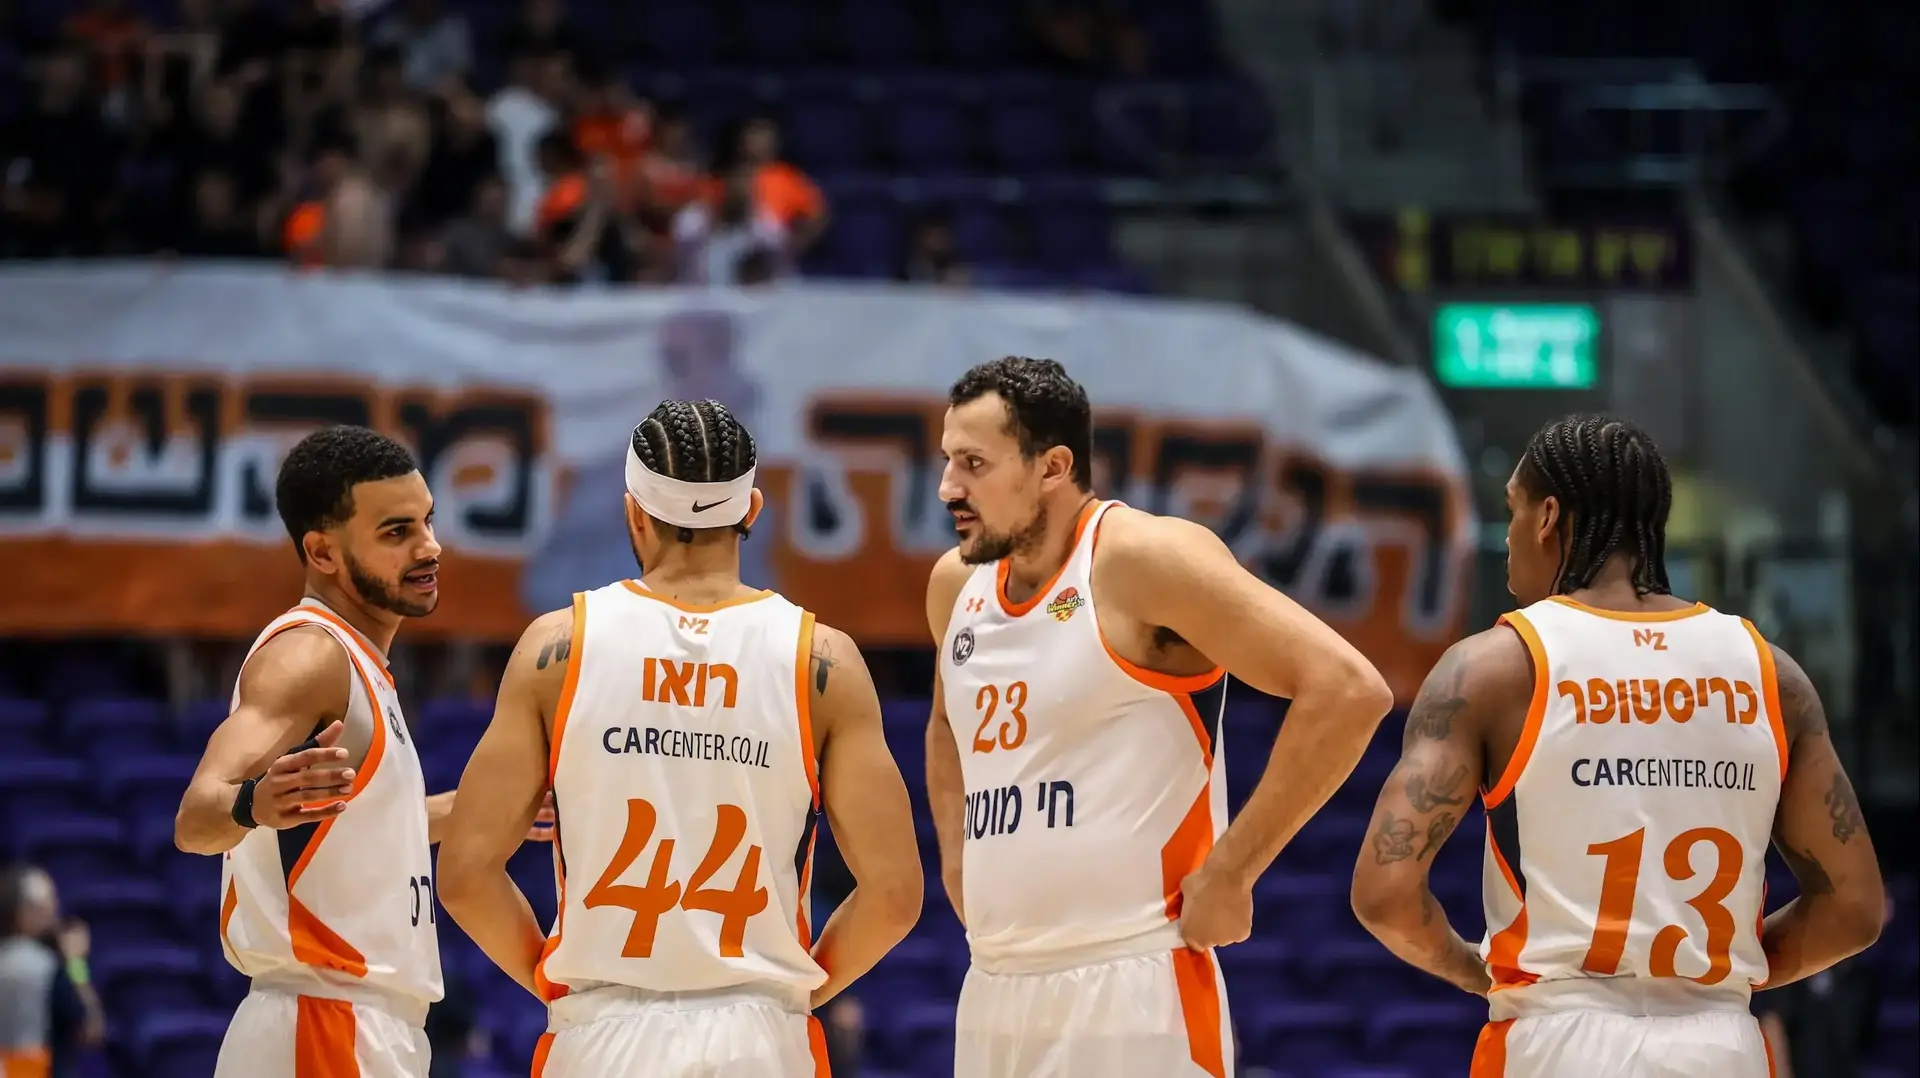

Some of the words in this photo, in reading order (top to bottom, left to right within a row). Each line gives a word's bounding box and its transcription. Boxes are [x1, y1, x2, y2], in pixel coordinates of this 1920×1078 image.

[678, 615, 709, 635] NZ
[1632, 628, 1668, 651] NZ
[642, 657, 739, 708] רואו
[1556, 676, 1759, 725] כריסטופר
[972, 680, 1028, 754] 23
[602, 726, 770, 769] CARCENTER.CO.IL
[1570, 757, 1756, 791] CARCENTER.CO.IL
[1037, 780, 1074, 828] חי
[583, 798, 768, 958] 44
[1581, 825, 1744, 986] 13
